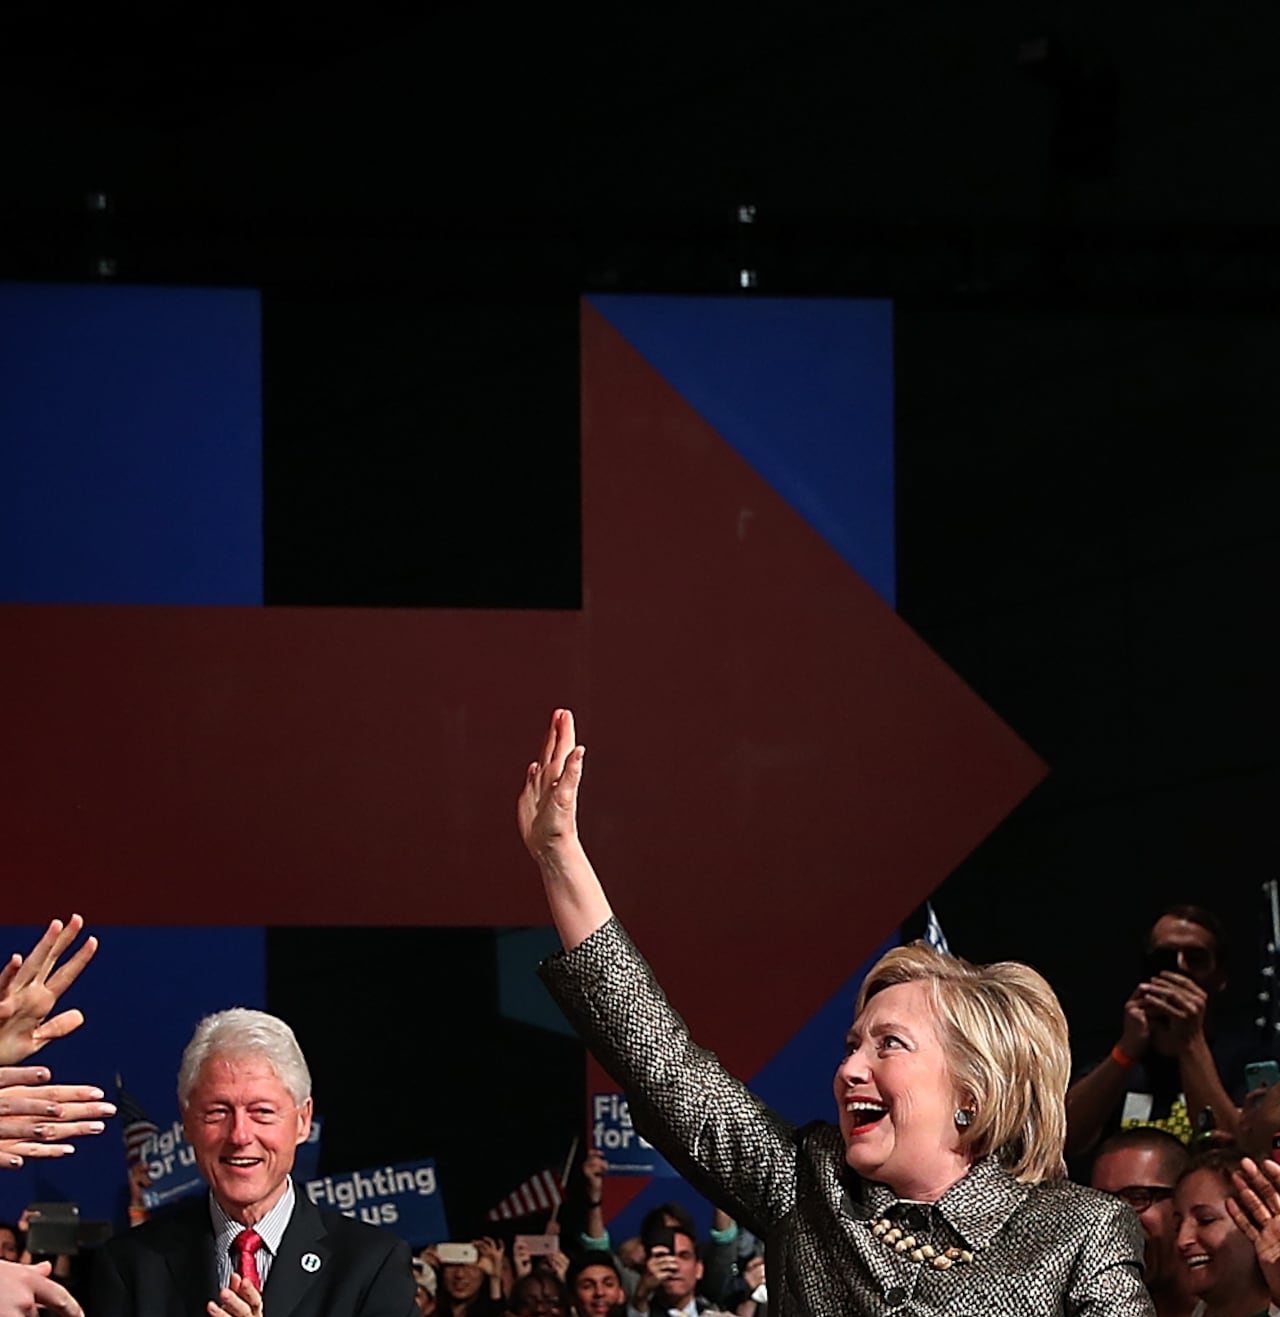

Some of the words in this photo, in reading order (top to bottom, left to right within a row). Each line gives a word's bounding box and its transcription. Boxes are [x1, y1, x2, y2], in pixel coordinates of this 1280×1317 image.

[593, 1121, 635, 1149] for
[147, 1153, 176, 1180] or
[306, 1166, 437, 1210] Fighting
